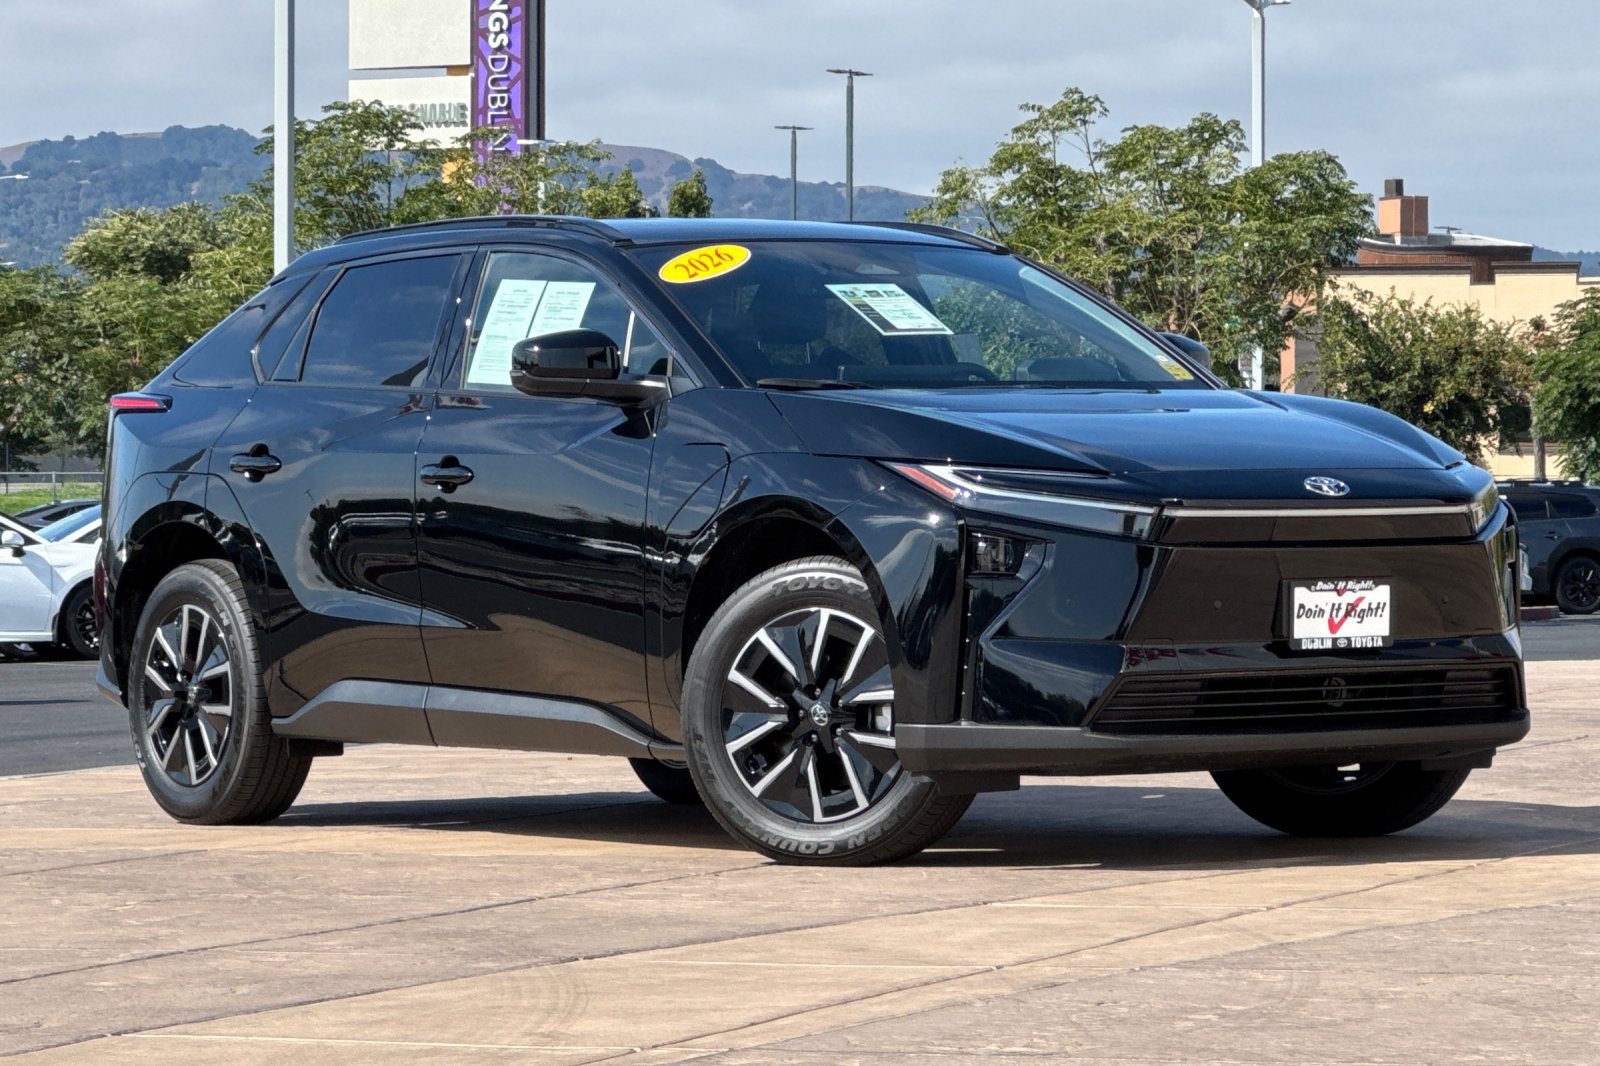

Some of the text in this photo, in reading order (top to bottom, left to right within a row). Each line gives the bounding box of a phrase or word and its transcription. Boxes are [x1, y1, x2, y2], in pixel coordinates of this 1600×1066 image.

[674, 248, 734, 278] 2026
[1296, 602, 1387, 624] Doin' It Right!
[1301, 636, 1383, 650] DUBLIN TOYOTA
